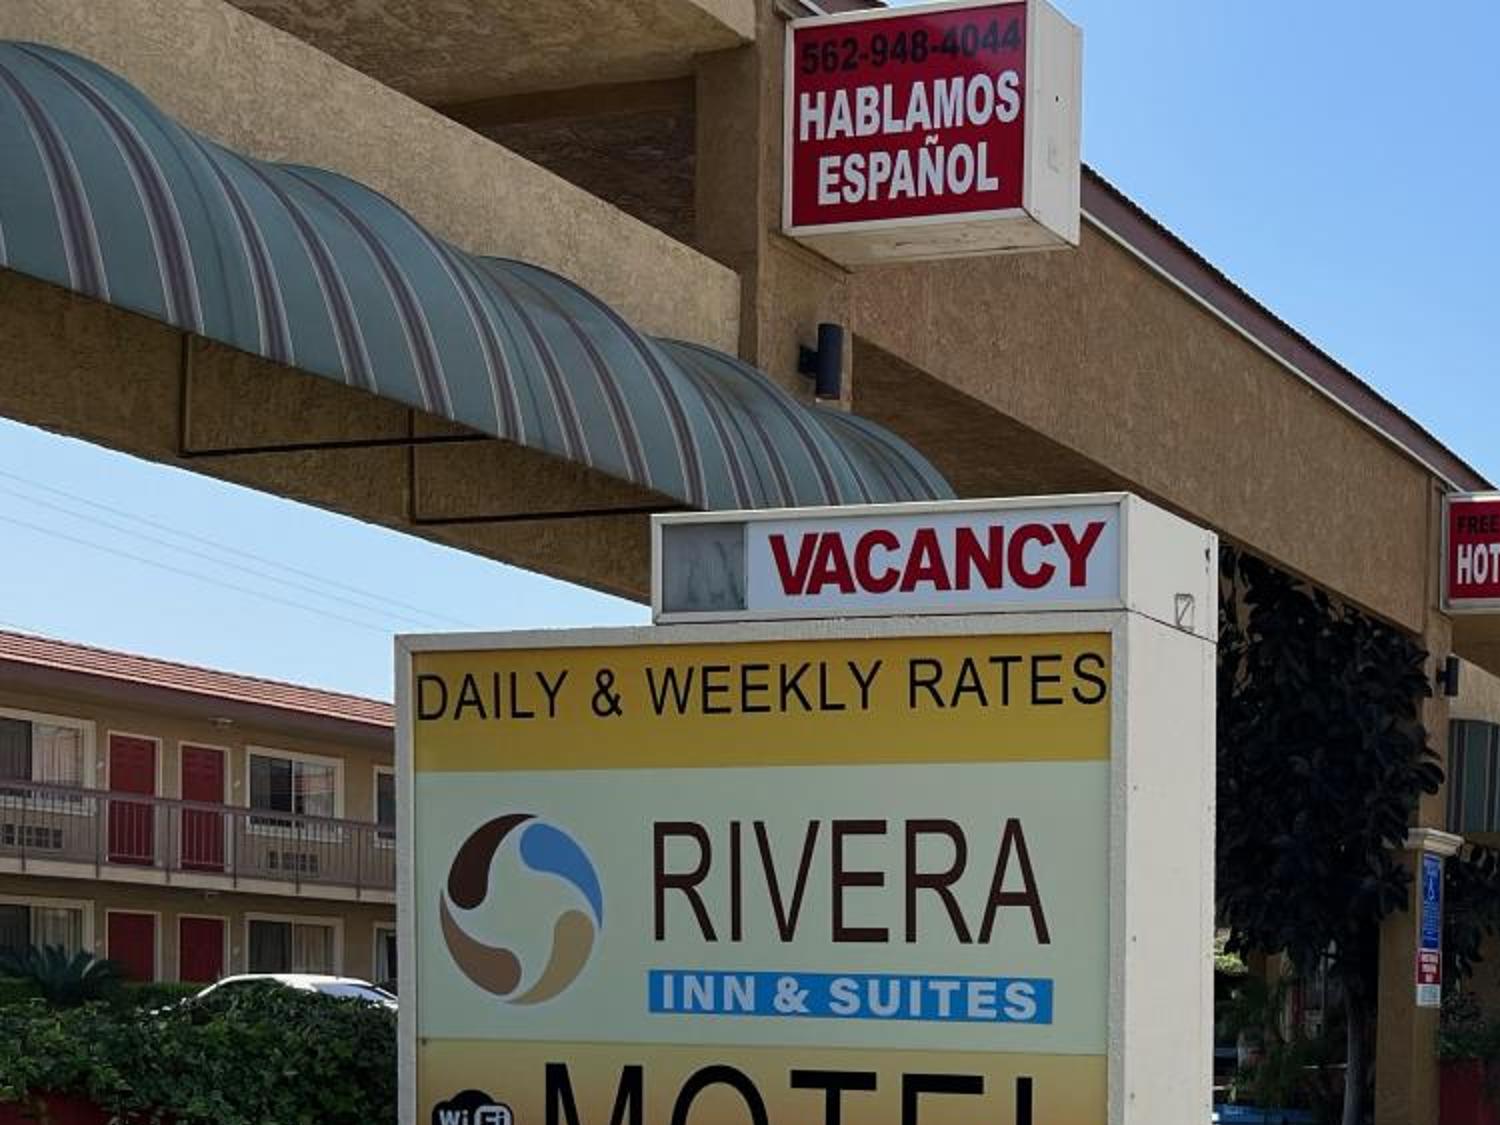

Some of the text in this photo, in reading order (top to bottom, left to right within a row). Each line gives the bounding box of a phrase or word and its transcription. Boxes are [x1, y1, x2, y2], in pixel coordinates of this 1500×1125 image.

[801, 17, 1022, 75] 562-948-4044
[800, 70, 1021, 142] HABLAMOS
[818, 135, 999, 205] ESPAÑOL
[769, 521, 1106, 595] VACANCY
[1457, 514, 1500, 534] FREE
[416, 652, 1107, 720] DAILY & WEEKLY RATES
[653, 818, 1051, 945] RIVERA
[662, 974, 1037, 1021] INN & SUITES
